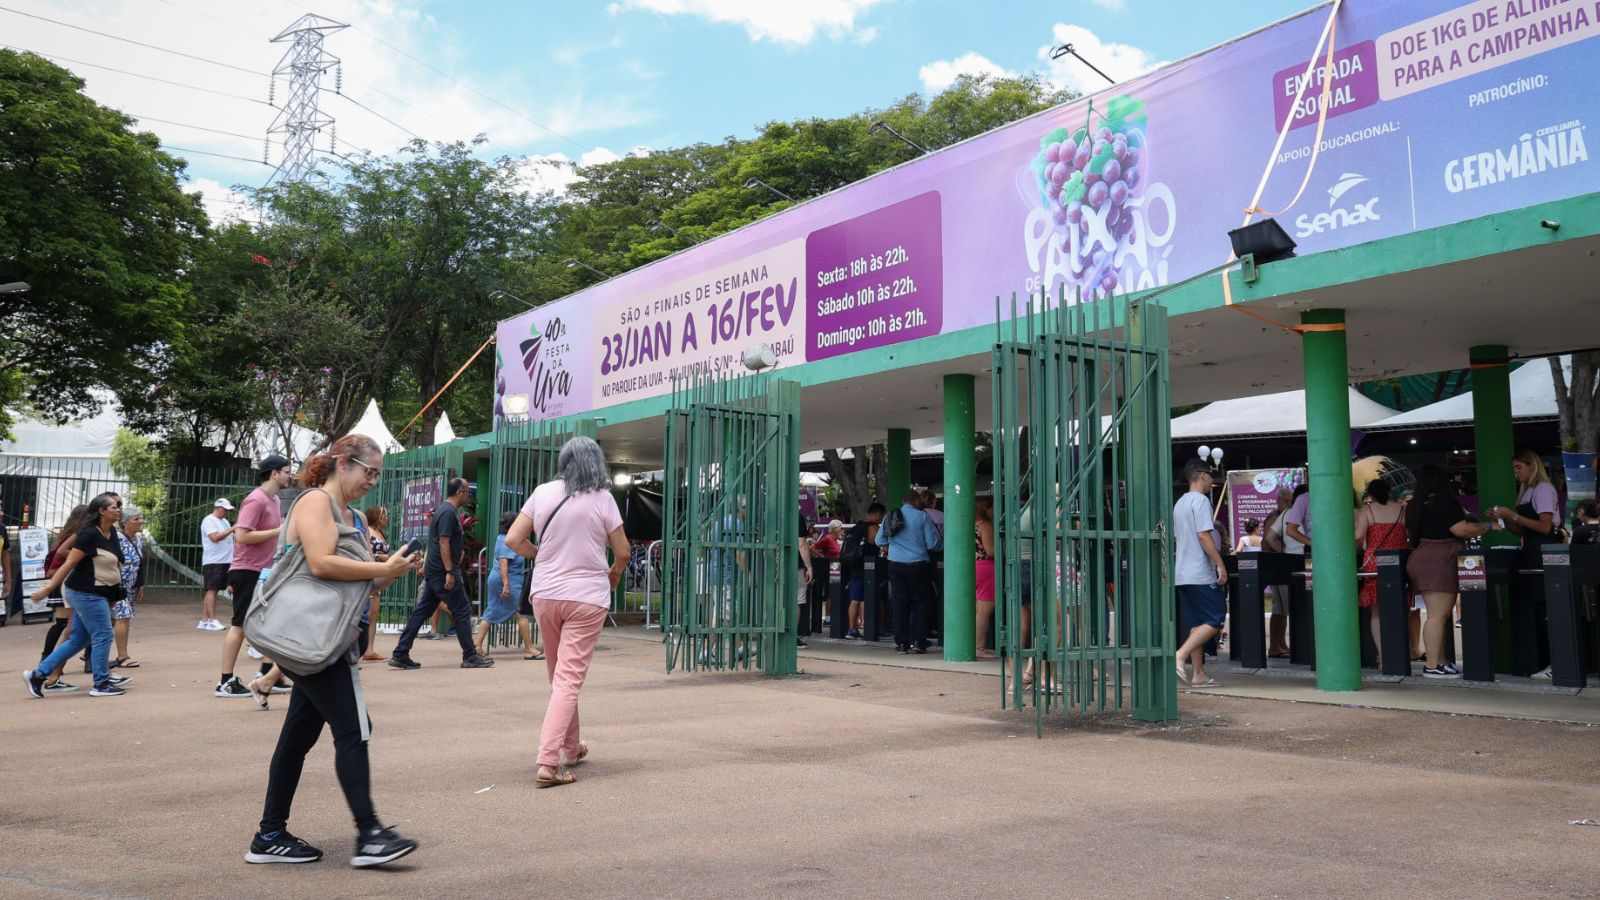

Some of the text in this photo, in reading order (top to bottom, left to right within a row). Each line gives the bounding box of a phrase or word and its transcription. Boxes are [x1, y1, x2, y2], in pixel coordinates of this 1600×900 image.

[1390, 32, 1427, 60] DOE
[1432, 18, 1467, 46] 1KG
[1472, 8, 1498, 34] DE
[1394, 56, 1444, 87] PARA
[1448, 50, 1462, 70] A
[1467, 8, 1590, 64] CAMPANHA
[1468, 74, 1549, 108] PATROCÍNIO:
[1277, 146, 1310, 164] APOIO
[1444, 128, 1588, 194] GERMÂNIA
[1024, 181, 1177, 292] PAIXÃO
[818, 246, 909, 287] Sexta: 18h às 22h.
[620, 264, 768, 325] SÃO 4 FINAIS DE SEMANA
[818, 276, 917, 317] Sábado 10h às 22h.
[600, 277, 798, 376] 23/JAN A 16/FEV
[818, 307, 927, 348] Domingo: 10h às 21h.
[546, 344, 570, 358] FESTA
[552, 359, 562, 370] DA
[534, 362, 573, 413] Uva
[602, 384, 611, 397] NO
[612, 376, 637, 395] PARQUE
[638, 375, 648, 390] DA
[649, 371, 664, 387] UVA
